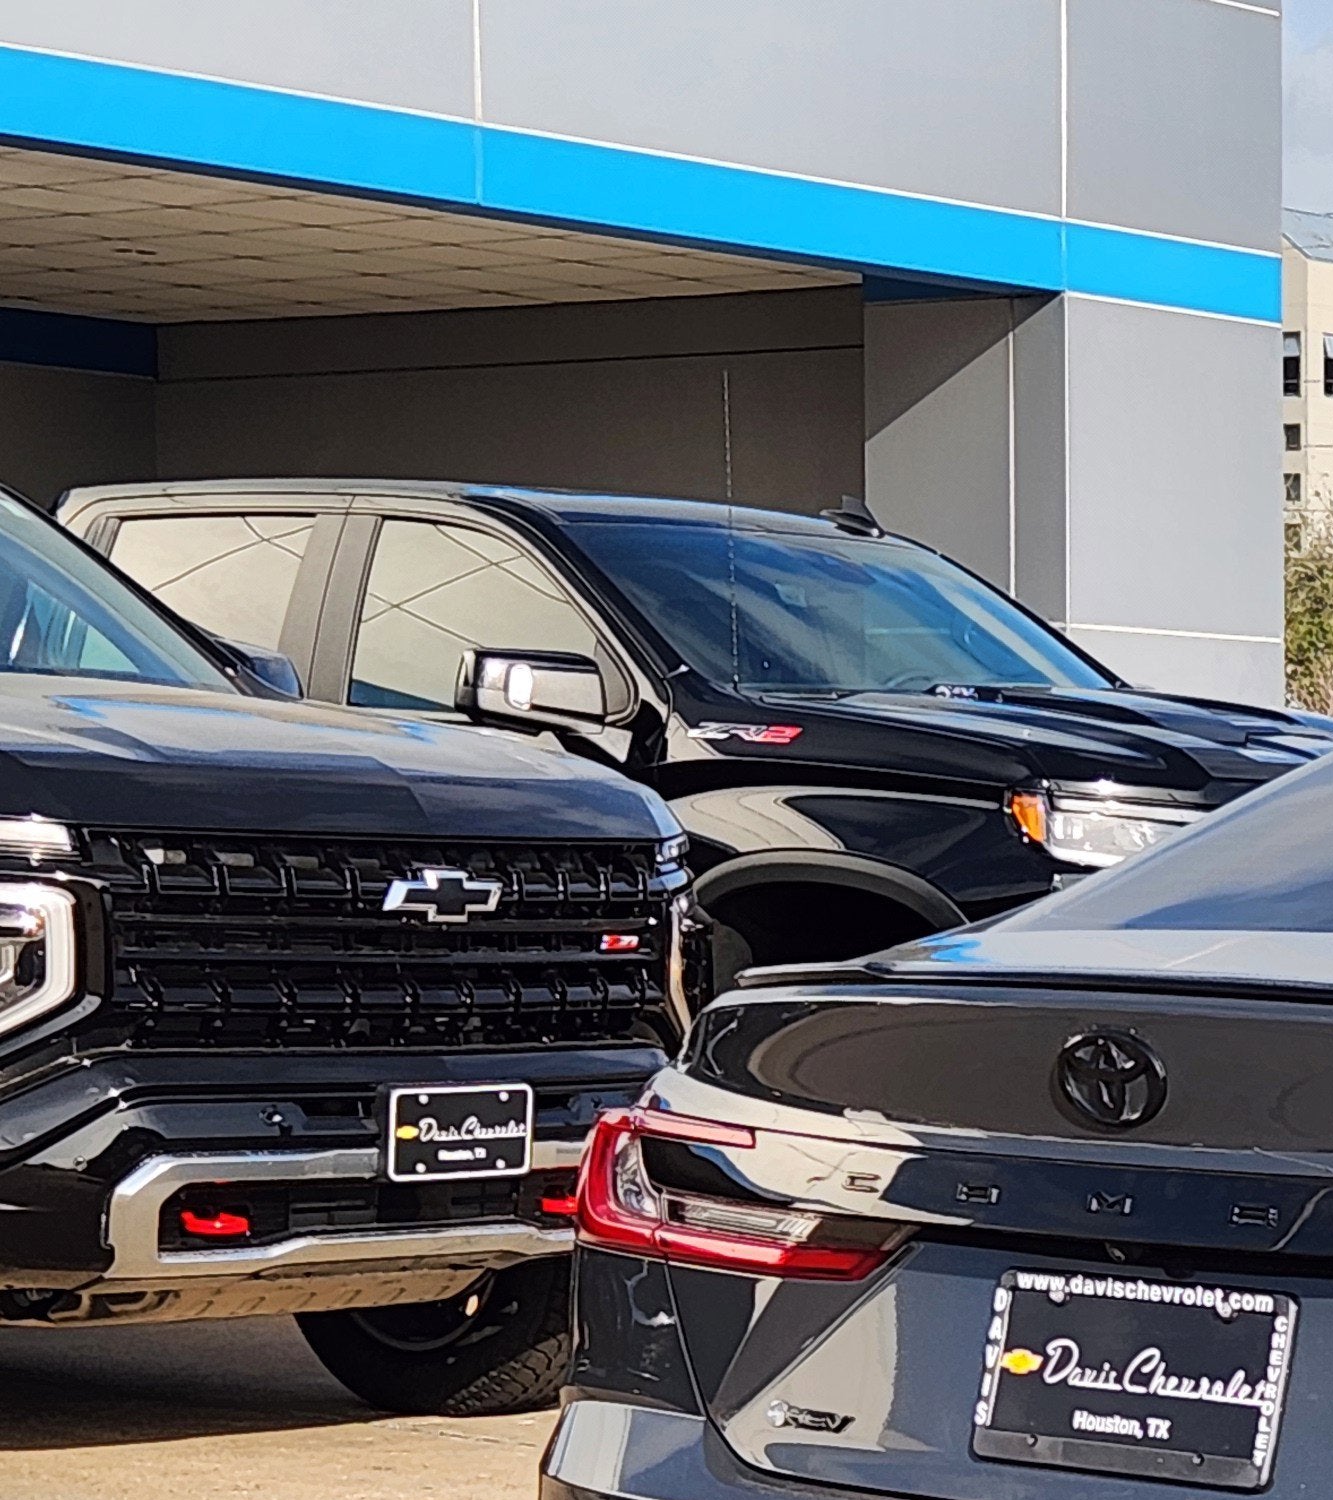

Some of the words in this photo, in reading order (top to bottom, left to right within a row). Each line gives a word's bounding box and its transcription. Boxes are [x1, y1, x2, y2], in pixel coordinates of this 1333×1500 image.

[687, 721, 803, 744] ZR2
[1016, 1271, 1275, 1314] www.davischevrolet.com
[974, 1287, 1008, 1426] DAVIS
[1042, 1338, 1123, 1392] Davis
[1121, 1347, 1268, 1408] Chevrolet
[1252, 1315, 1290, 1468] CHEVROLET
[1072, 1409, 1144, 1440] Houston,
[1146, 1416, 1173, 1440] TX
